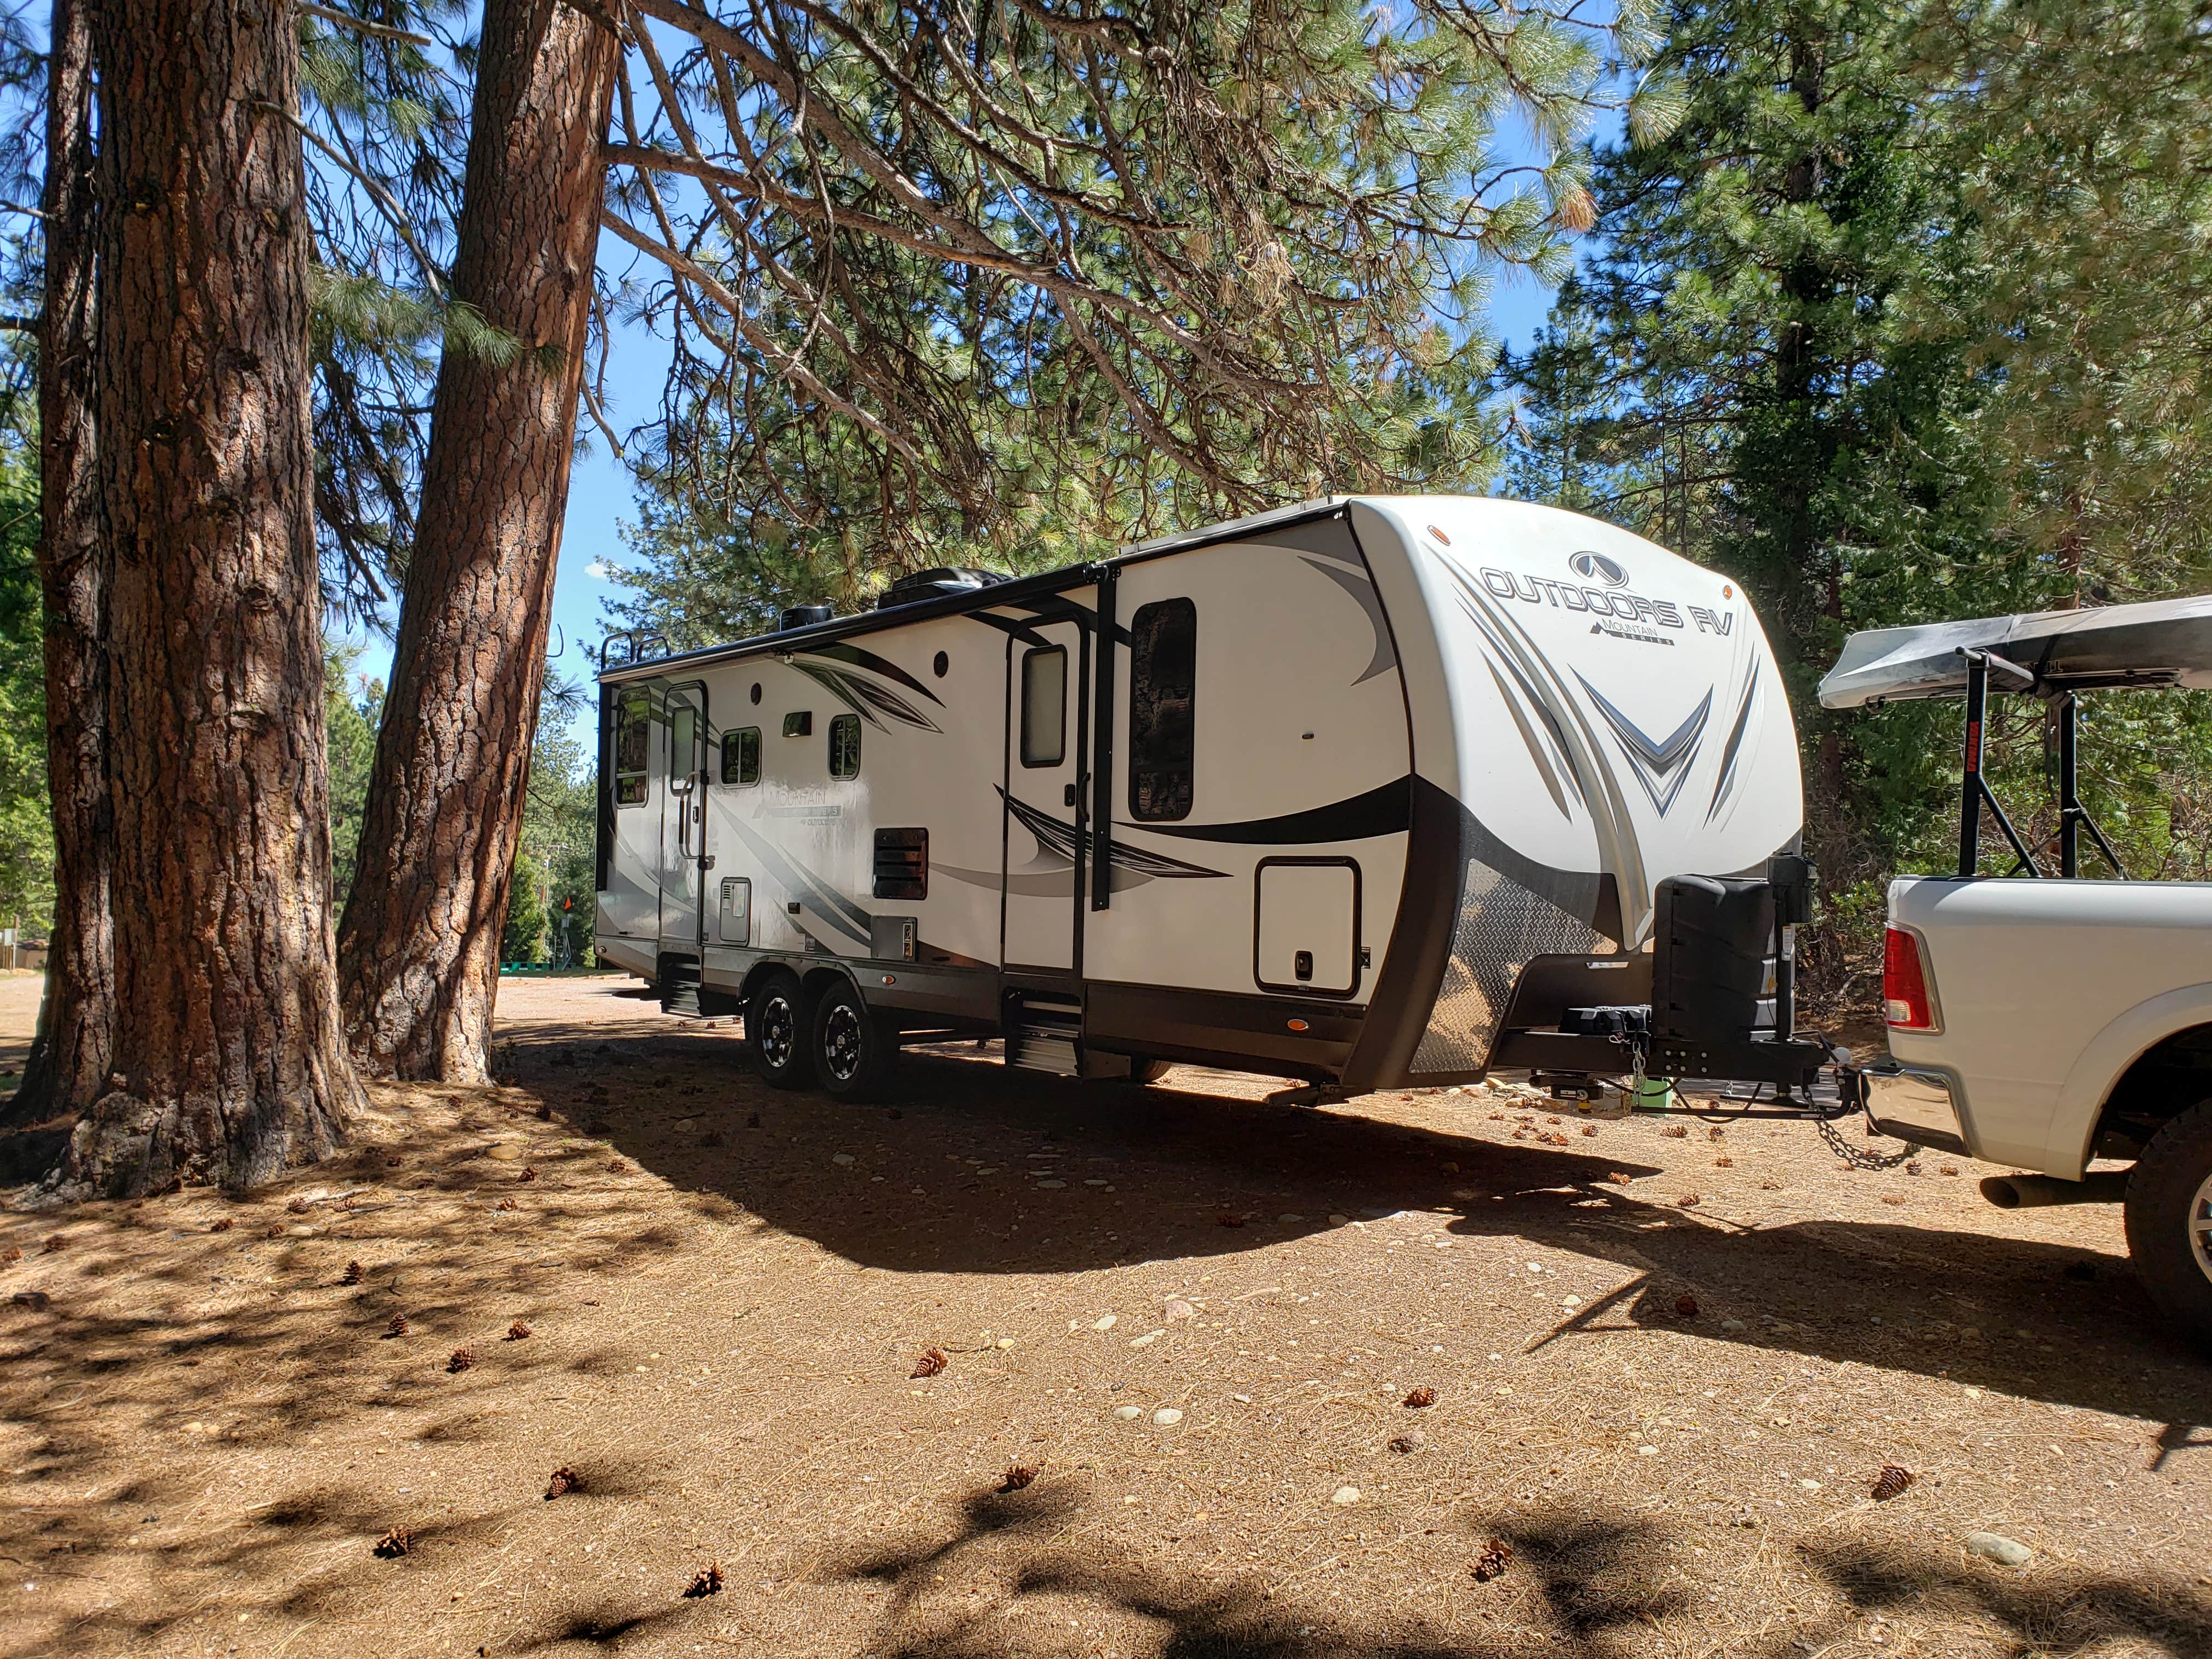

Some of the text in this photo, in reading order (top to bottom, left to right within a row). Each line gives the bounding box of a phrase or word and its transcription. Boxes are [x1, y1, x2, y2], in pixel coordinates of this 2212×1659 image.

[1480, 567, 1733, 636] OUTDOORS RV
[1602, 618, 1658, 636] MOUNTAIN
[1622, 633, 1671, 645] SERIES
[770, 790, 826, 806] MOUNTAIN
[783, 807, 837, 816] SERES
